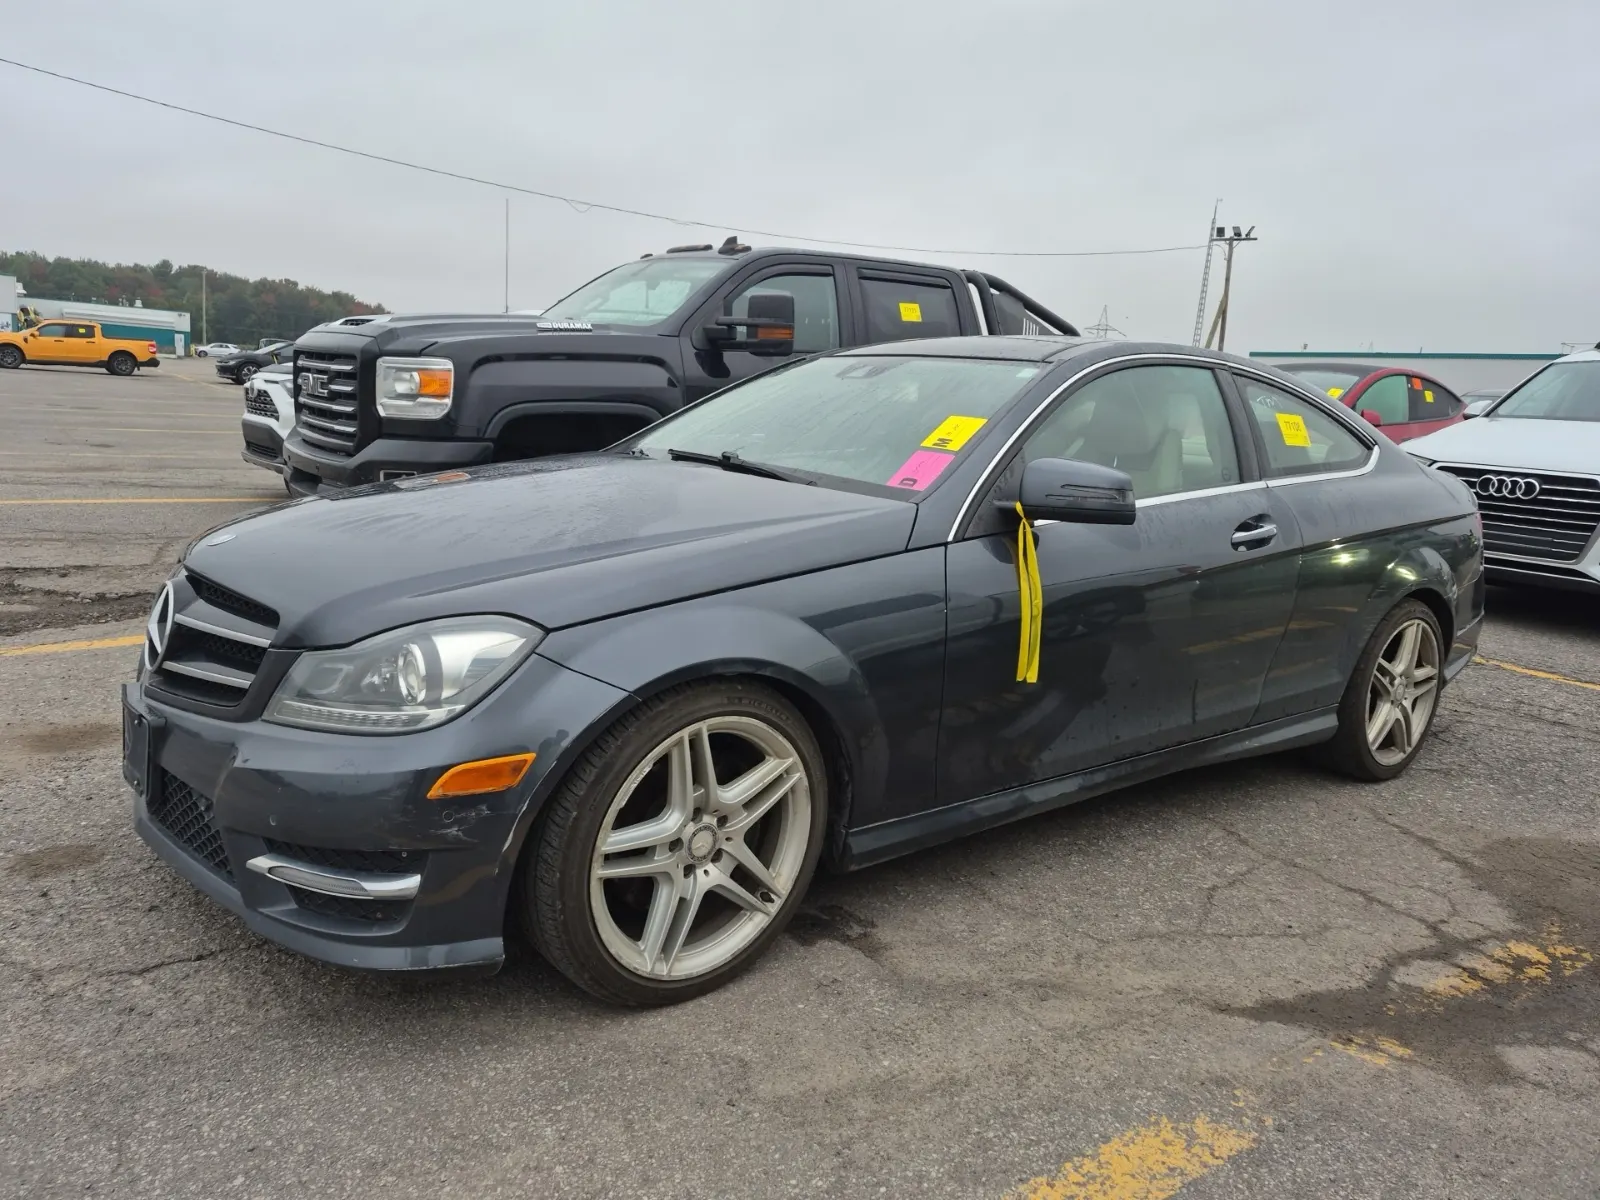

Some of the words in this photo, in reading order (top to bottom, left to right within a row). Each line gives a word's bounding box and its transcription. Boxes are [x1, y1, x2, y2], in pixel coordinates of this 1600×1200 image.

[552, 322, 593, 330] DURAMAX
[298, 372, 329, 397] GMC
[931, 437, 954, 448] M
[897, 477, 918, 488] D
